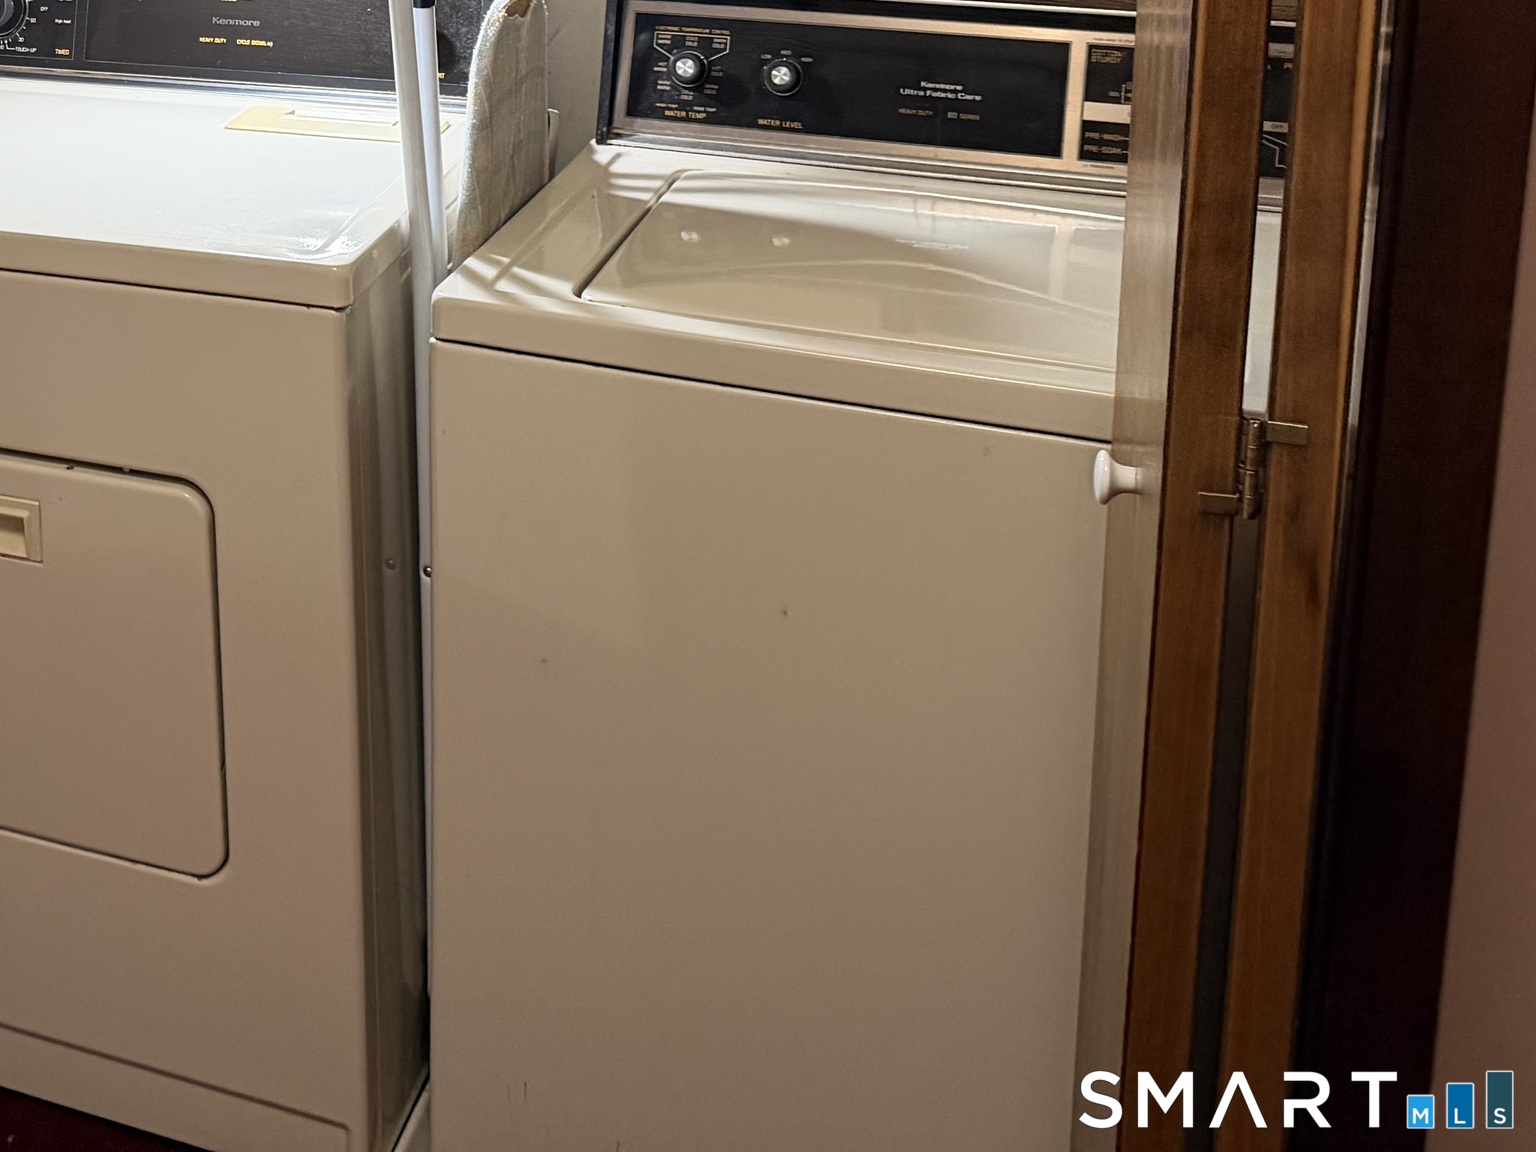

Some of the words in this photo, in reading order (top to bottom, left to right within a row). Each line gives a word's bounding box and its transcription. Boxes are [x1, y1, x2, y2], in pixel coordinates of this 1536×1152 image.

[212, 16, 261, 27] Kenmore
[920, 81, 963, 90] Kenmore
[900, 88, 924, 96] Ultra
[926, 90, 956, 99] Fabric
[957, 92, 982, 101] Care
[757, 118, 781, 127] WATER
[782, 121, 804, 129] LEVEL
